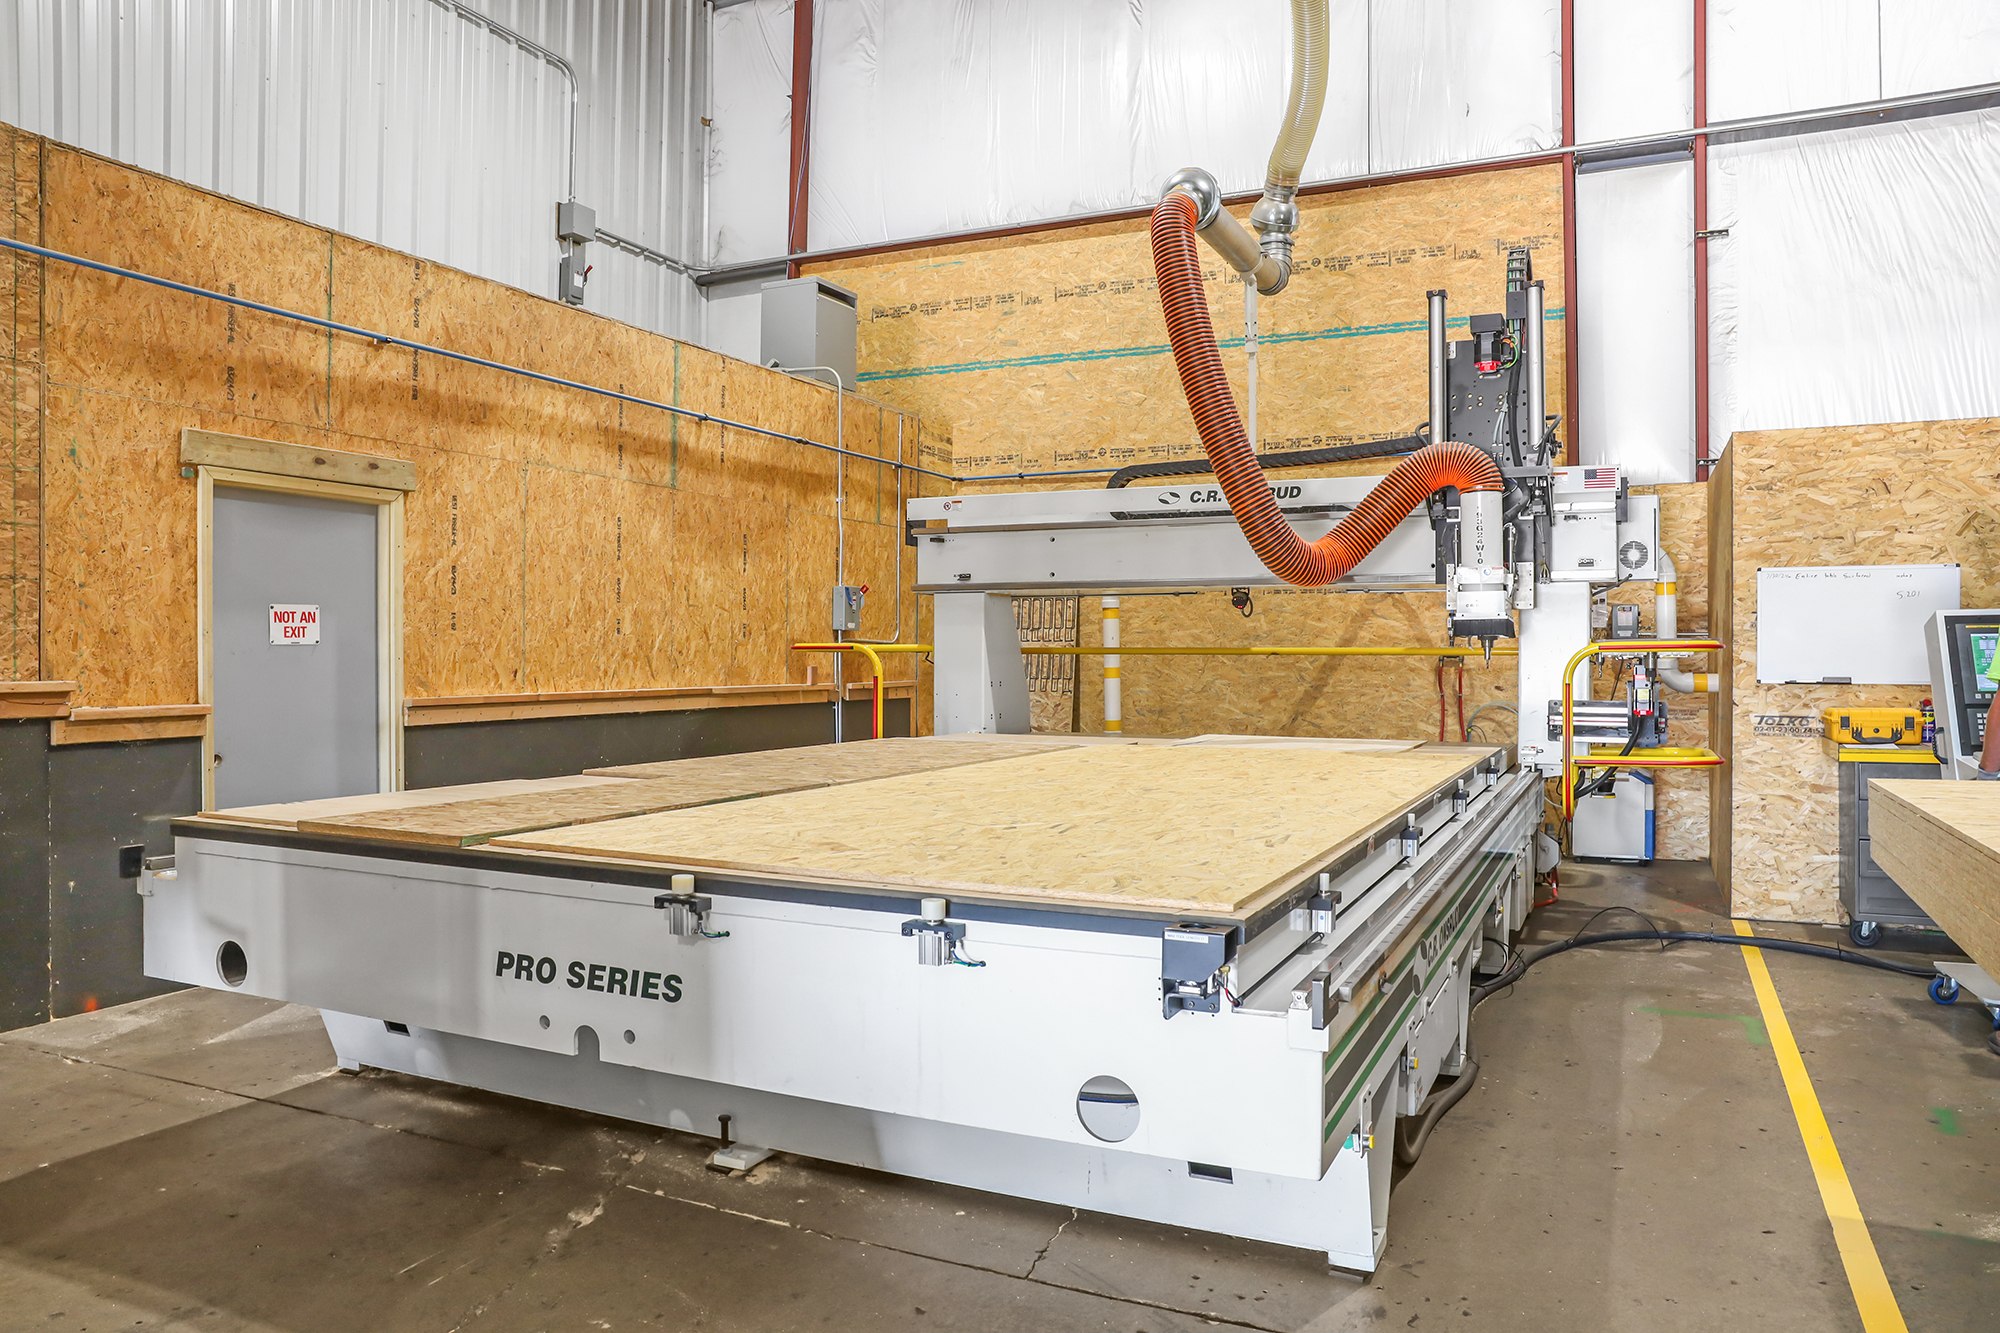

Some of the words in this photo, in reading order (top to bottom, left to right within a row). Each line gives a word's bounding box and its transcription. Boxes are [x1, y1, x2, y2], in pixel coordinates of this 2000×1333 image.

[1189, 490, 1222, 504] C.R.
[273, 611, 297, 623] NOT
[299, 611, 316, 623] AN
[283, 625, 307, 638] EXIT
[1754, 715, 1815, 727] TOLKO
[496, 951, 557, 984] PRO
[566, 961, 684, 1003] SERIES
